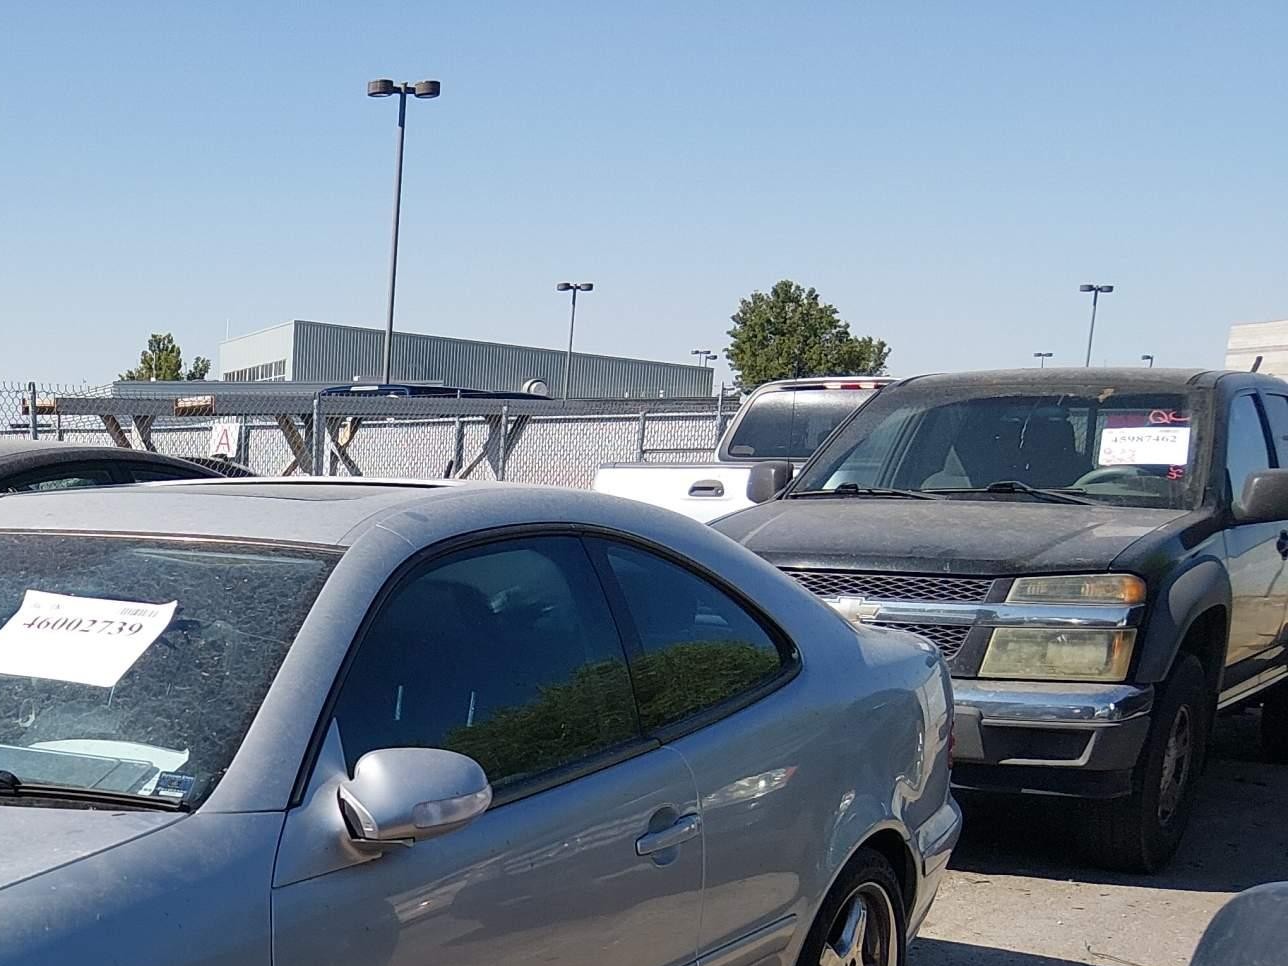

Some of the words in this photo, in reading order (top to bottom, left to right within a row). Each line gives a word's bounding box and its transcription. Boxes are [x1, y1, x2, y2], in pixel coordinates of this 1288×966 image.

[215, 428, 231, 453] A
[1111, 434, 1178, 444] 45987462
[22, 615, 145, 637] 46002739
